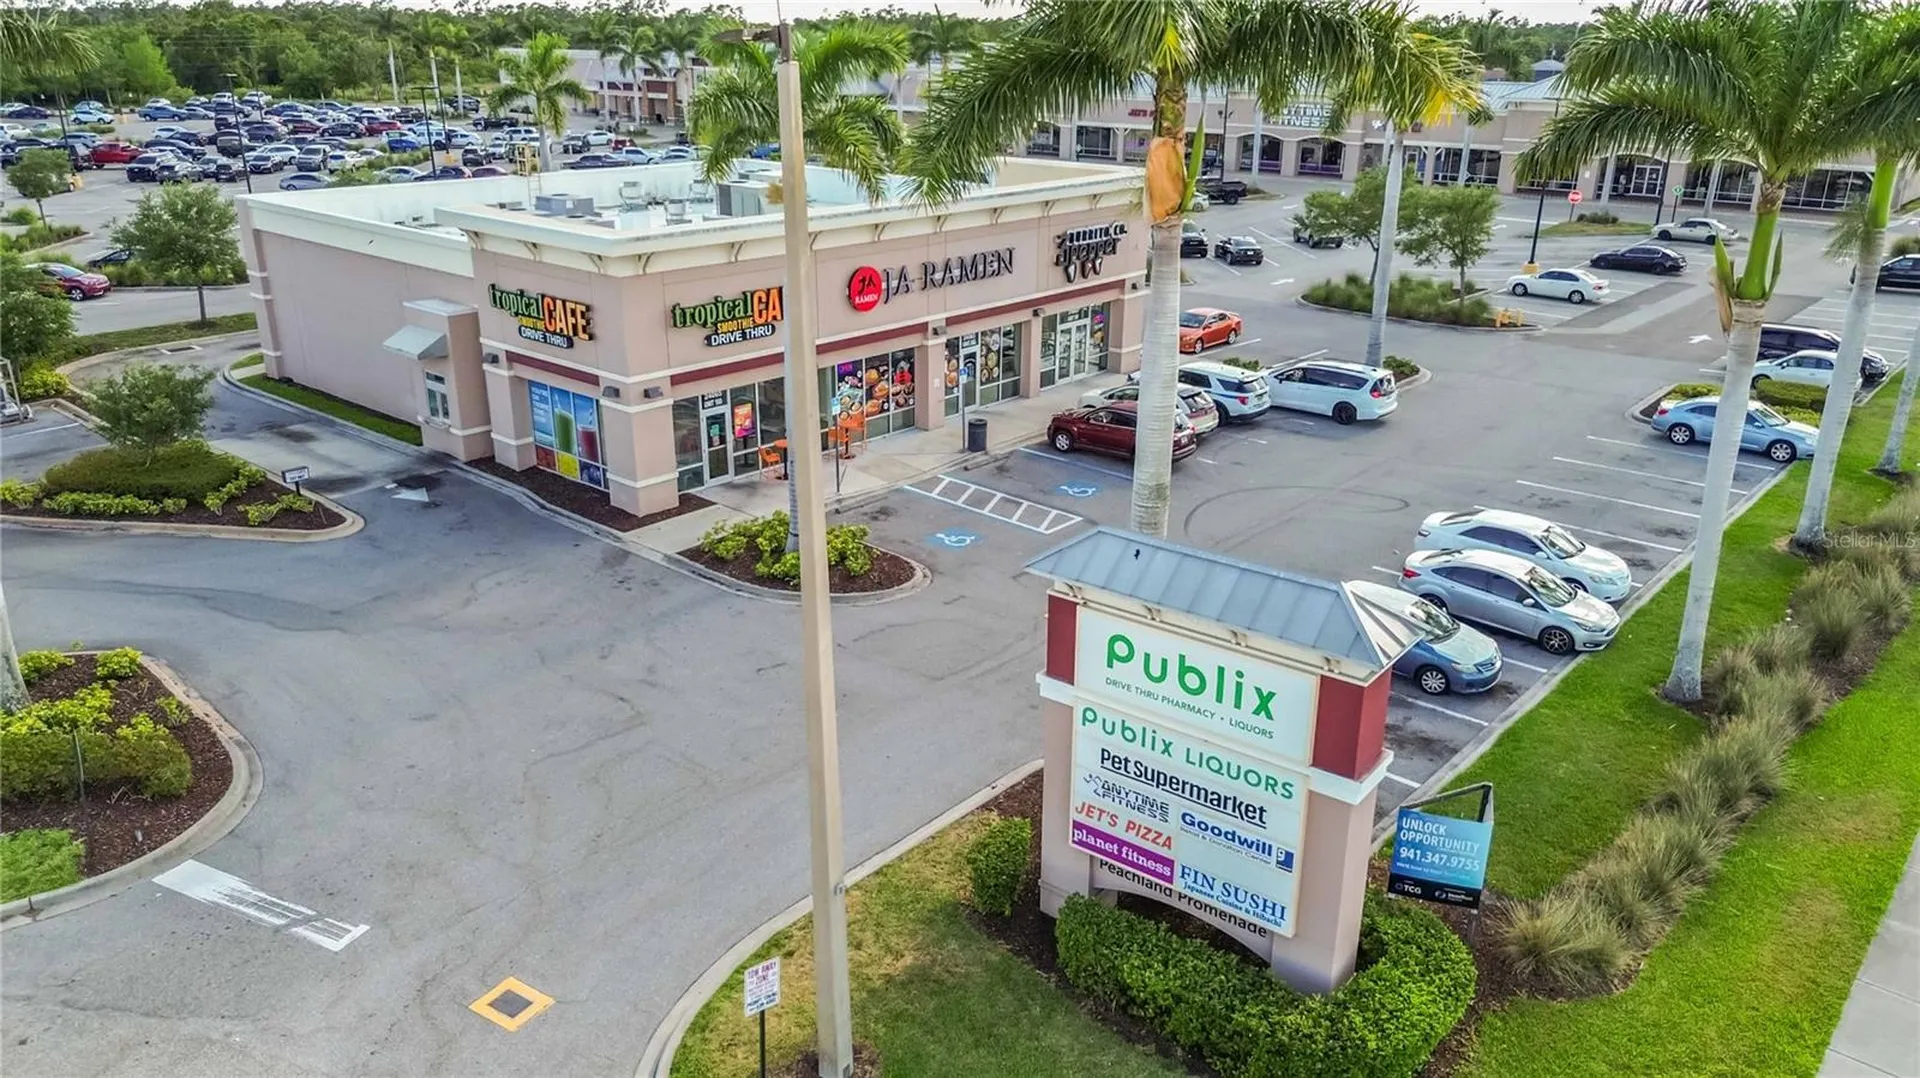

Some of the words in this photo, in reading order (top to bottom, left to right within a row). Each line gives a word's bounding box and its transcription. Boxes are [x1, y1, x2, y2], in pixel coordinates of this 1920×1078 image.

[921, 247, 1016, 291] RAMEN
[489, 284, 544, 319] tropical
[543, 294, 593, 341] CAFE
[673, 291, 752, 329] tropical
[752, 286, 784, 324] CA
[855, 293, 878, 304] RAMEN
[520, 326, 545, 342] DRIVE
[546, 331, 568, 348] THRU
[711, 330, 743, 346] DRIVE
[745, 324, 773, 340] THRU
[717, 317, 754, 333] SMOOTHIE
[1106, 634, 1277, 721] Publix
[1105, 677, 1132, 692] DRIVE
[1134, 686, 1159, 701] THRU
[1161, 695, 1217, 720] PHARMACY
[1229, 717, 1274, 739] LIQUORS
[1082, 707, 1174, 758] Publix
[1185, 747, 1295, 800] LIQUORS
[1101, 780, 1169, 812] ANYTIME
[1102, 791, 1169, 824] FITNESS
[1075, 802, 1119, 828] JET'S
[1125, 820, 1173, 850] PIZZA
[1181, 810, 1273, 857] Goodwill
[1400, 830, 1480, 856] OPPORTUNITY
[1402, 817, 1448, 835] UNLOCK
[1073, 828, 1118, 855] planet
[1120, 846, 1171, 877] fitness
[1399, 846, 1481, 871] 941.347.9755
[1179, 863, 1217, 891] FIN
[1220, 882, 1287, 921] SUSHI
[1183, 881, 1215, 899] Japanese
[1216, 894, 1243, 911] Cuisine
[1252, 909, 1282, 928] Hibachi
[1403, 884, 1422, 895] TCG
